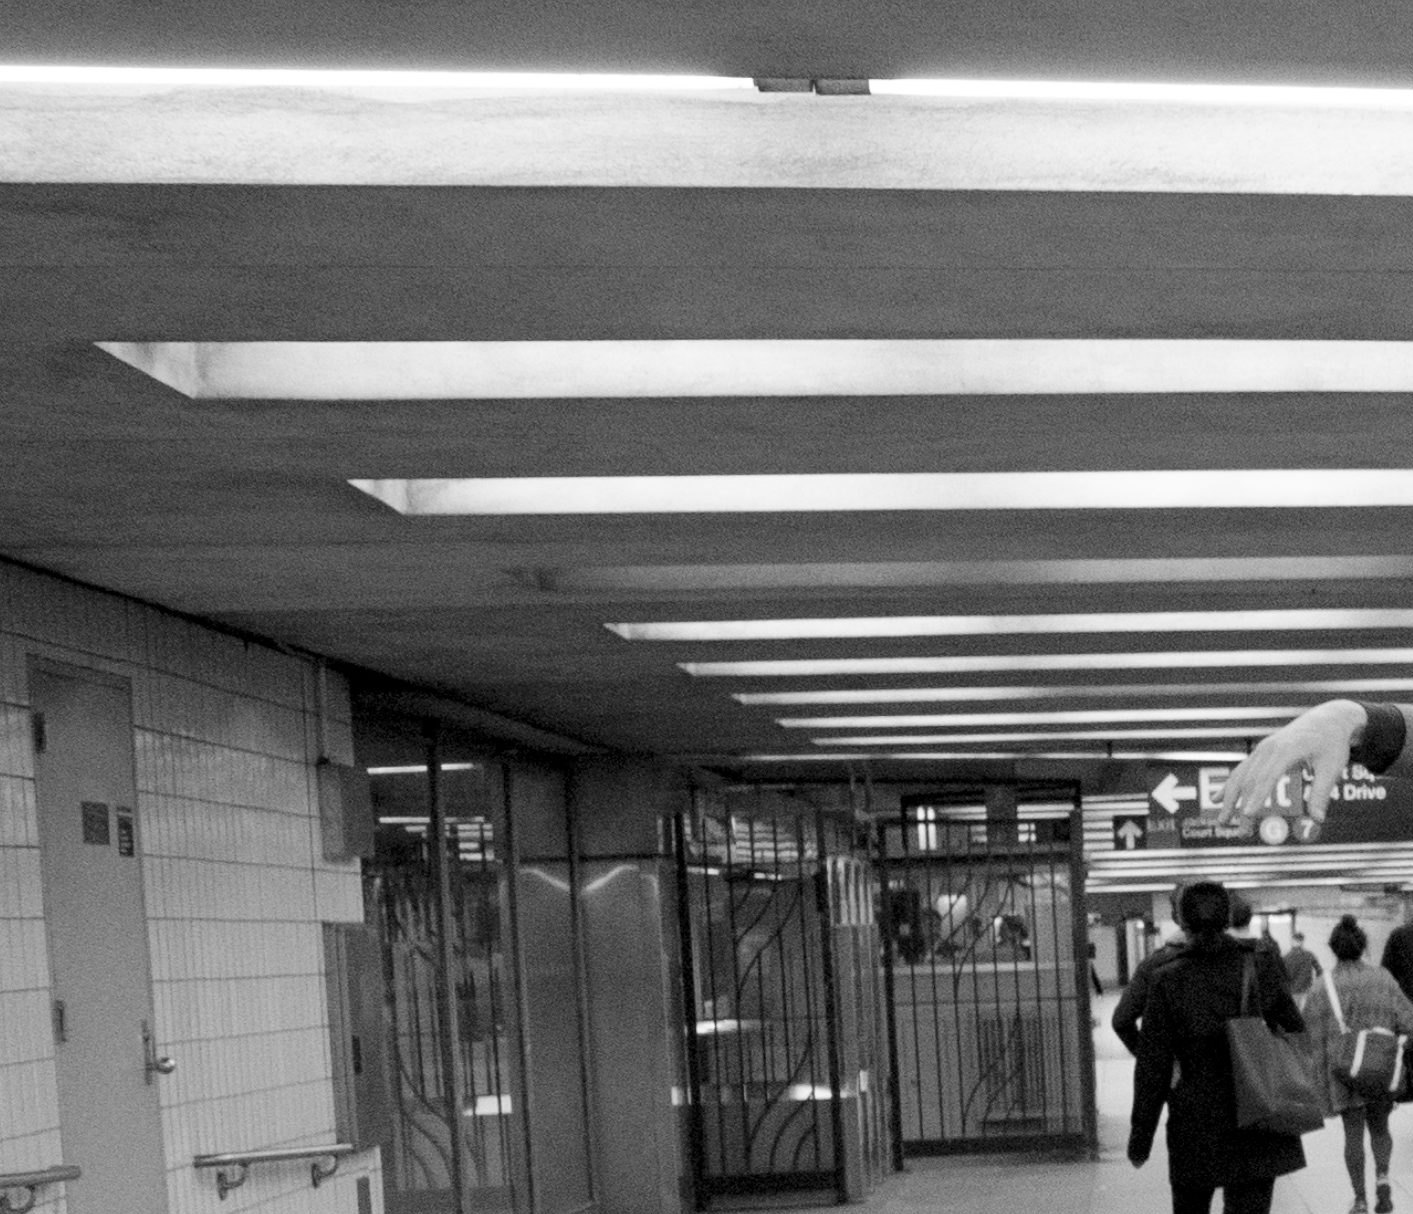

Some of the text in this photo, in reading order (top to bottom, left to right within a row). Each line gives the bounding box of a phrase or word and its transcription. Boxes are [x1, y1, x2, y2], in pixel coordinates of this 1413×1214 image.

[1200, 766, 1291, 811] Et
[1343, 783, 1387, 801] Drive
[1264, 820, 1283, 839] G
[1300, 819, 1314, 839] 7
